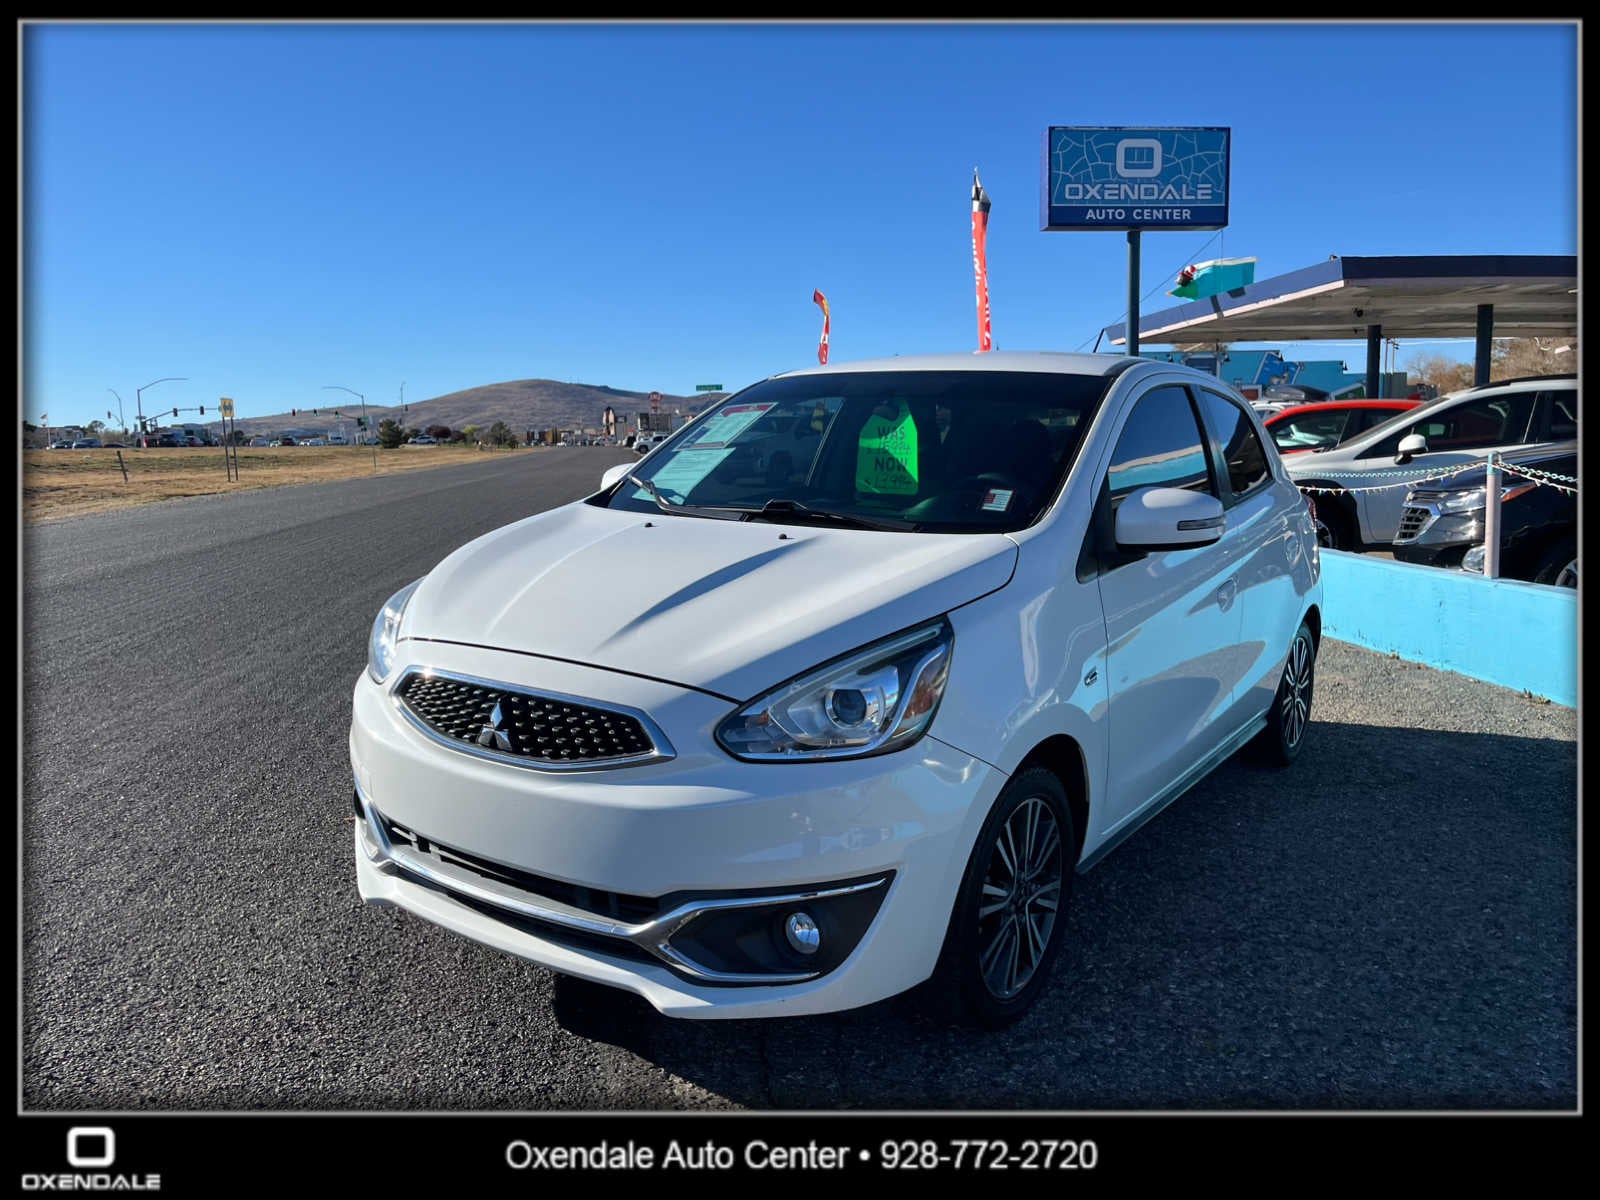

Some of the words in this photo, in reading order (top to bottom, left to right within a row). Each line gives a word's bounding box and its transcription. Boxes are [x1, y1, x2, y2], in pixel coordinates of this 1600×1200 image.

[1064, 183, 1212, 200] OXENDALE
[1086, 209, 1126, 220] AUTO
[1132, 209, 1191, 220] CENTER
[874, 456, 908, 472] NOW
